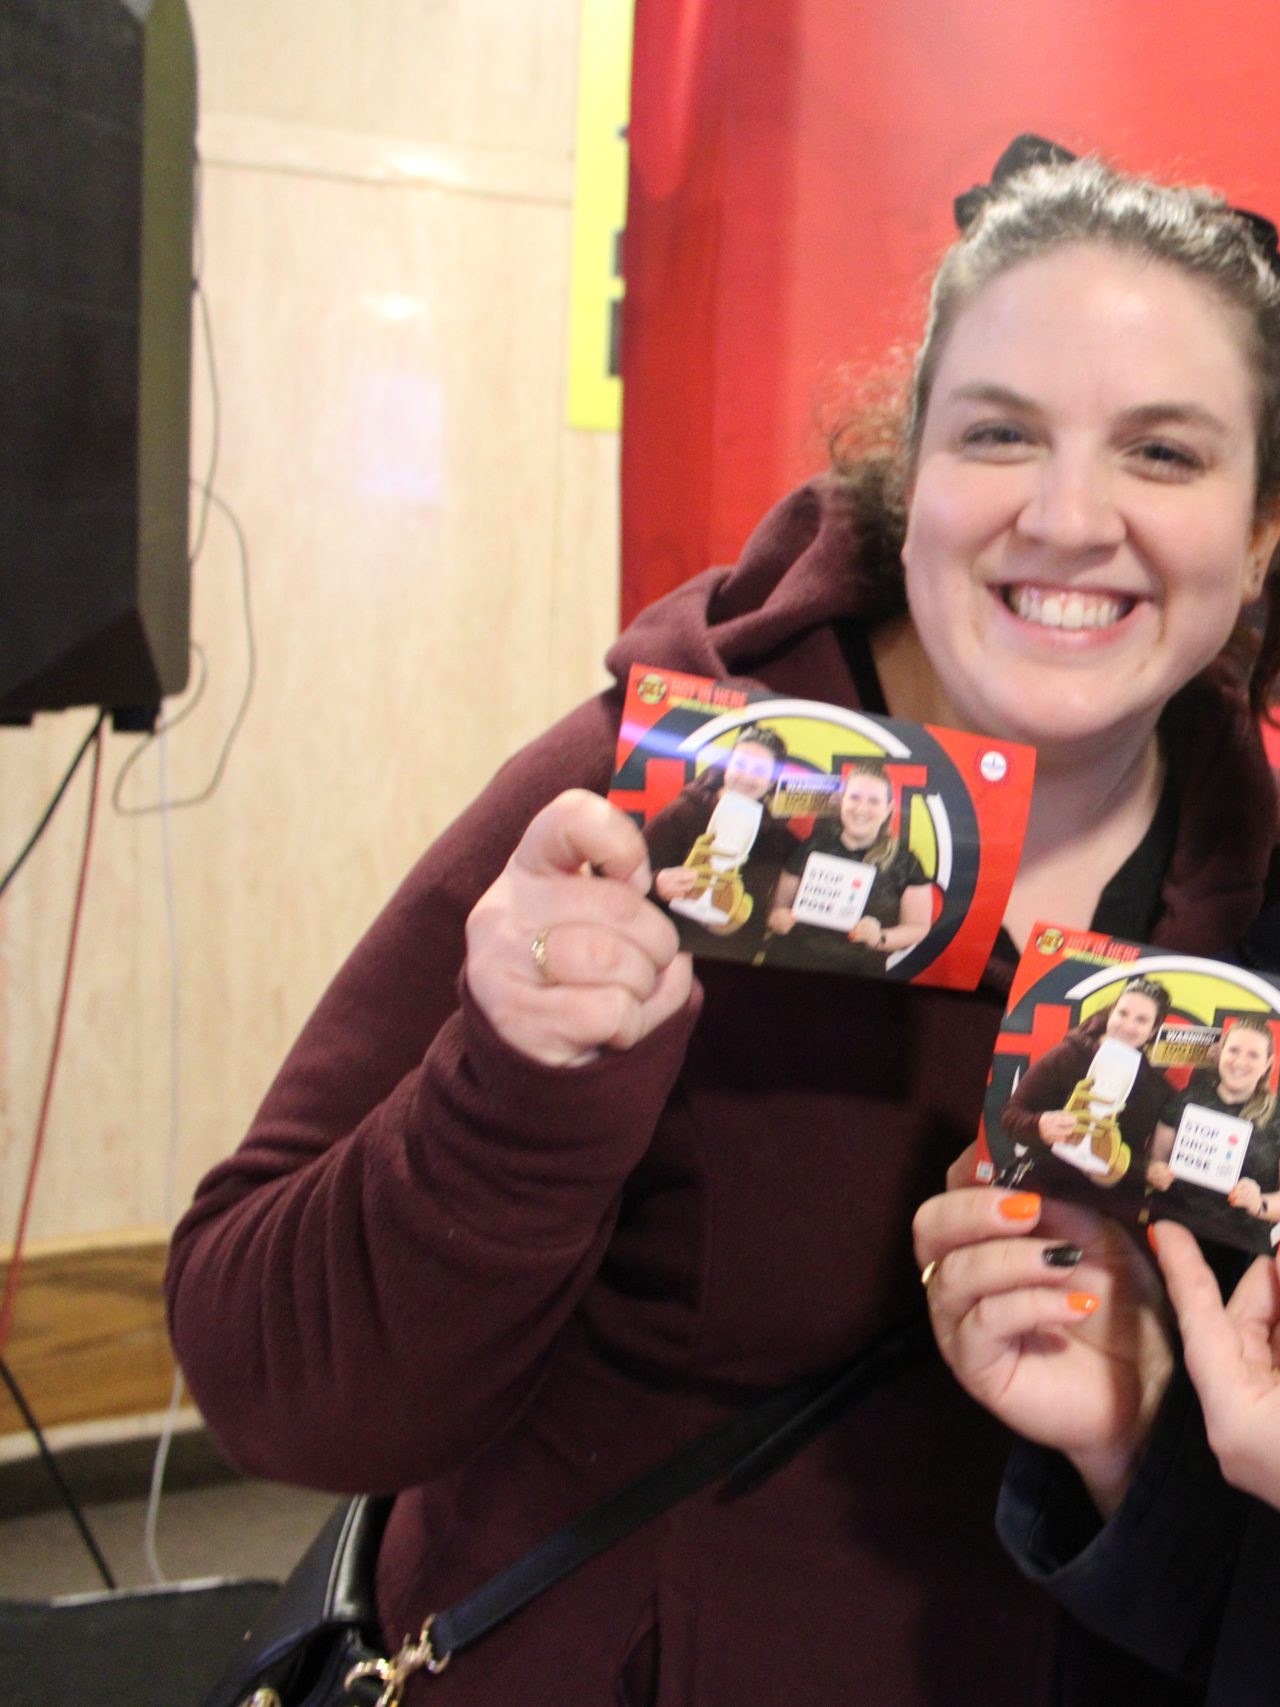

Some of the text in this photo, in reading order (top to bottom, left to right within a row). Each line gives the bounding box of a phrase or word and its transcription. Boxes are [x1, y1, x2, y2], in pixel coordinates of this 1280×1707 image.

[809, 868, 844, 883] STOP
[804, 883, 842, 898] DROP
[800, 898, 834, 914] POSE
[1066, 934, 1092, 951] HOT
[1106, 941, 1142, 963] HERE
[1185, 1121, 1220, 1138] STOP
[1180, 1136, 1218, 1155] DROP
[1176, 1151, 1211, 1170] POSE
